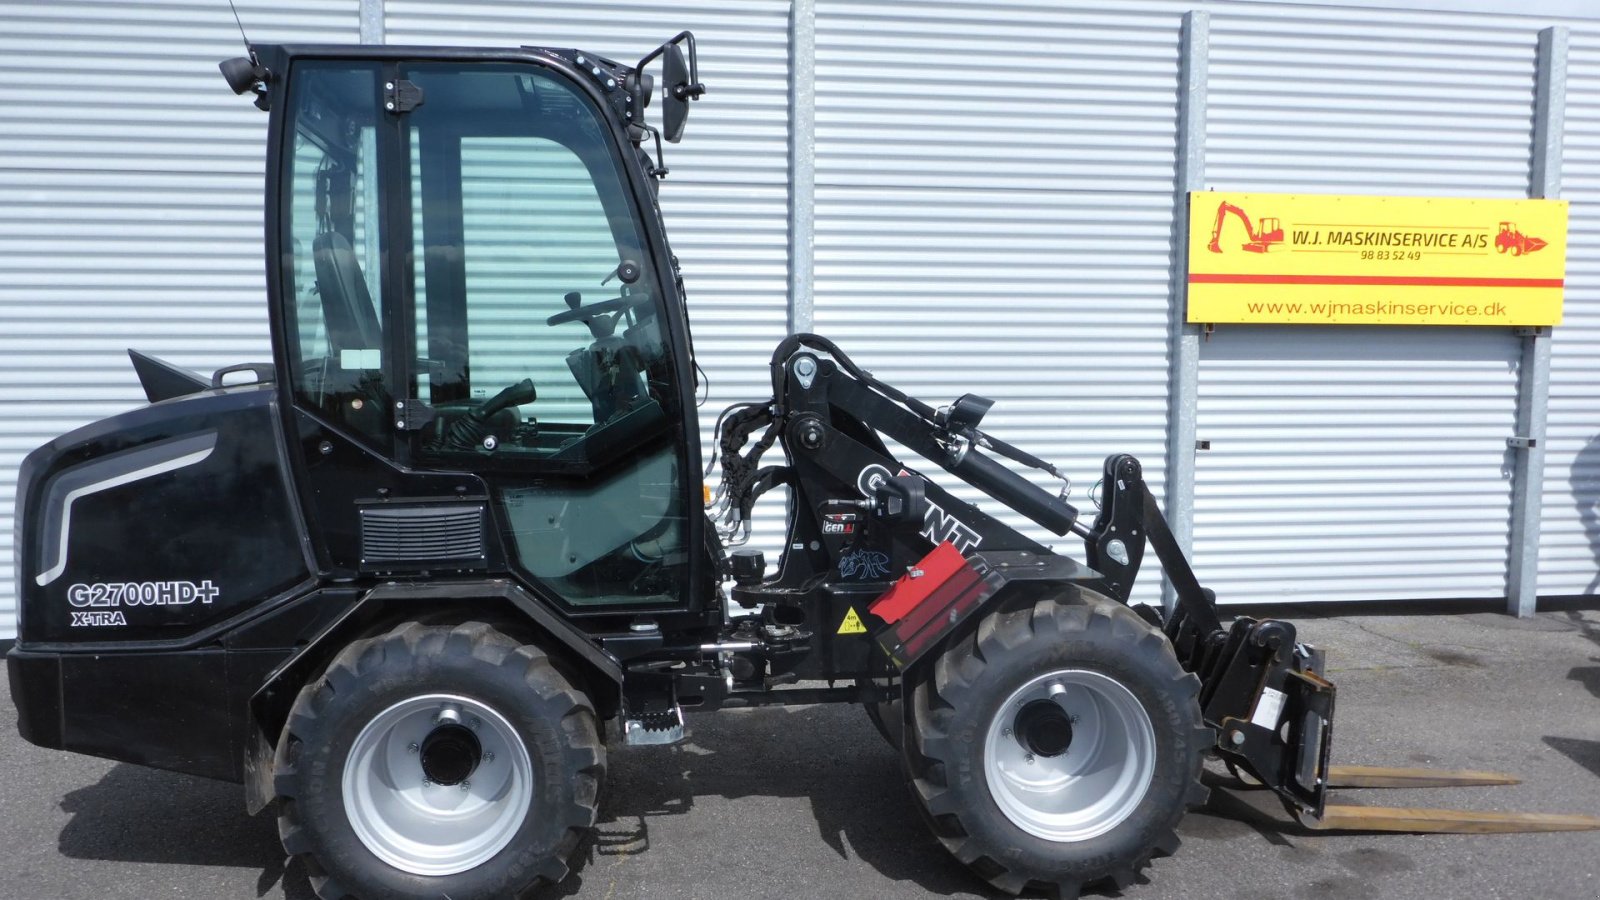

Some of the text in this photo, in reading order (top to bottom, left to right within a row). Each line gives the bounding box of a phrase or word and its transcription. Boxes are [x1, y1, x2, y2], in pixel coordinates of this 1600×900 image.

[1292, 230, 1489, 249] W.J. MASKINSERVICE A/S
[1360, 250, 1421, 261] 98 83 52 49
[1247, 300, 1507, 318] www.wjmaskinservice.dk
[67, 580, 220, 608] G2700HD+
[70, 610, 127, 627] X-TRA
